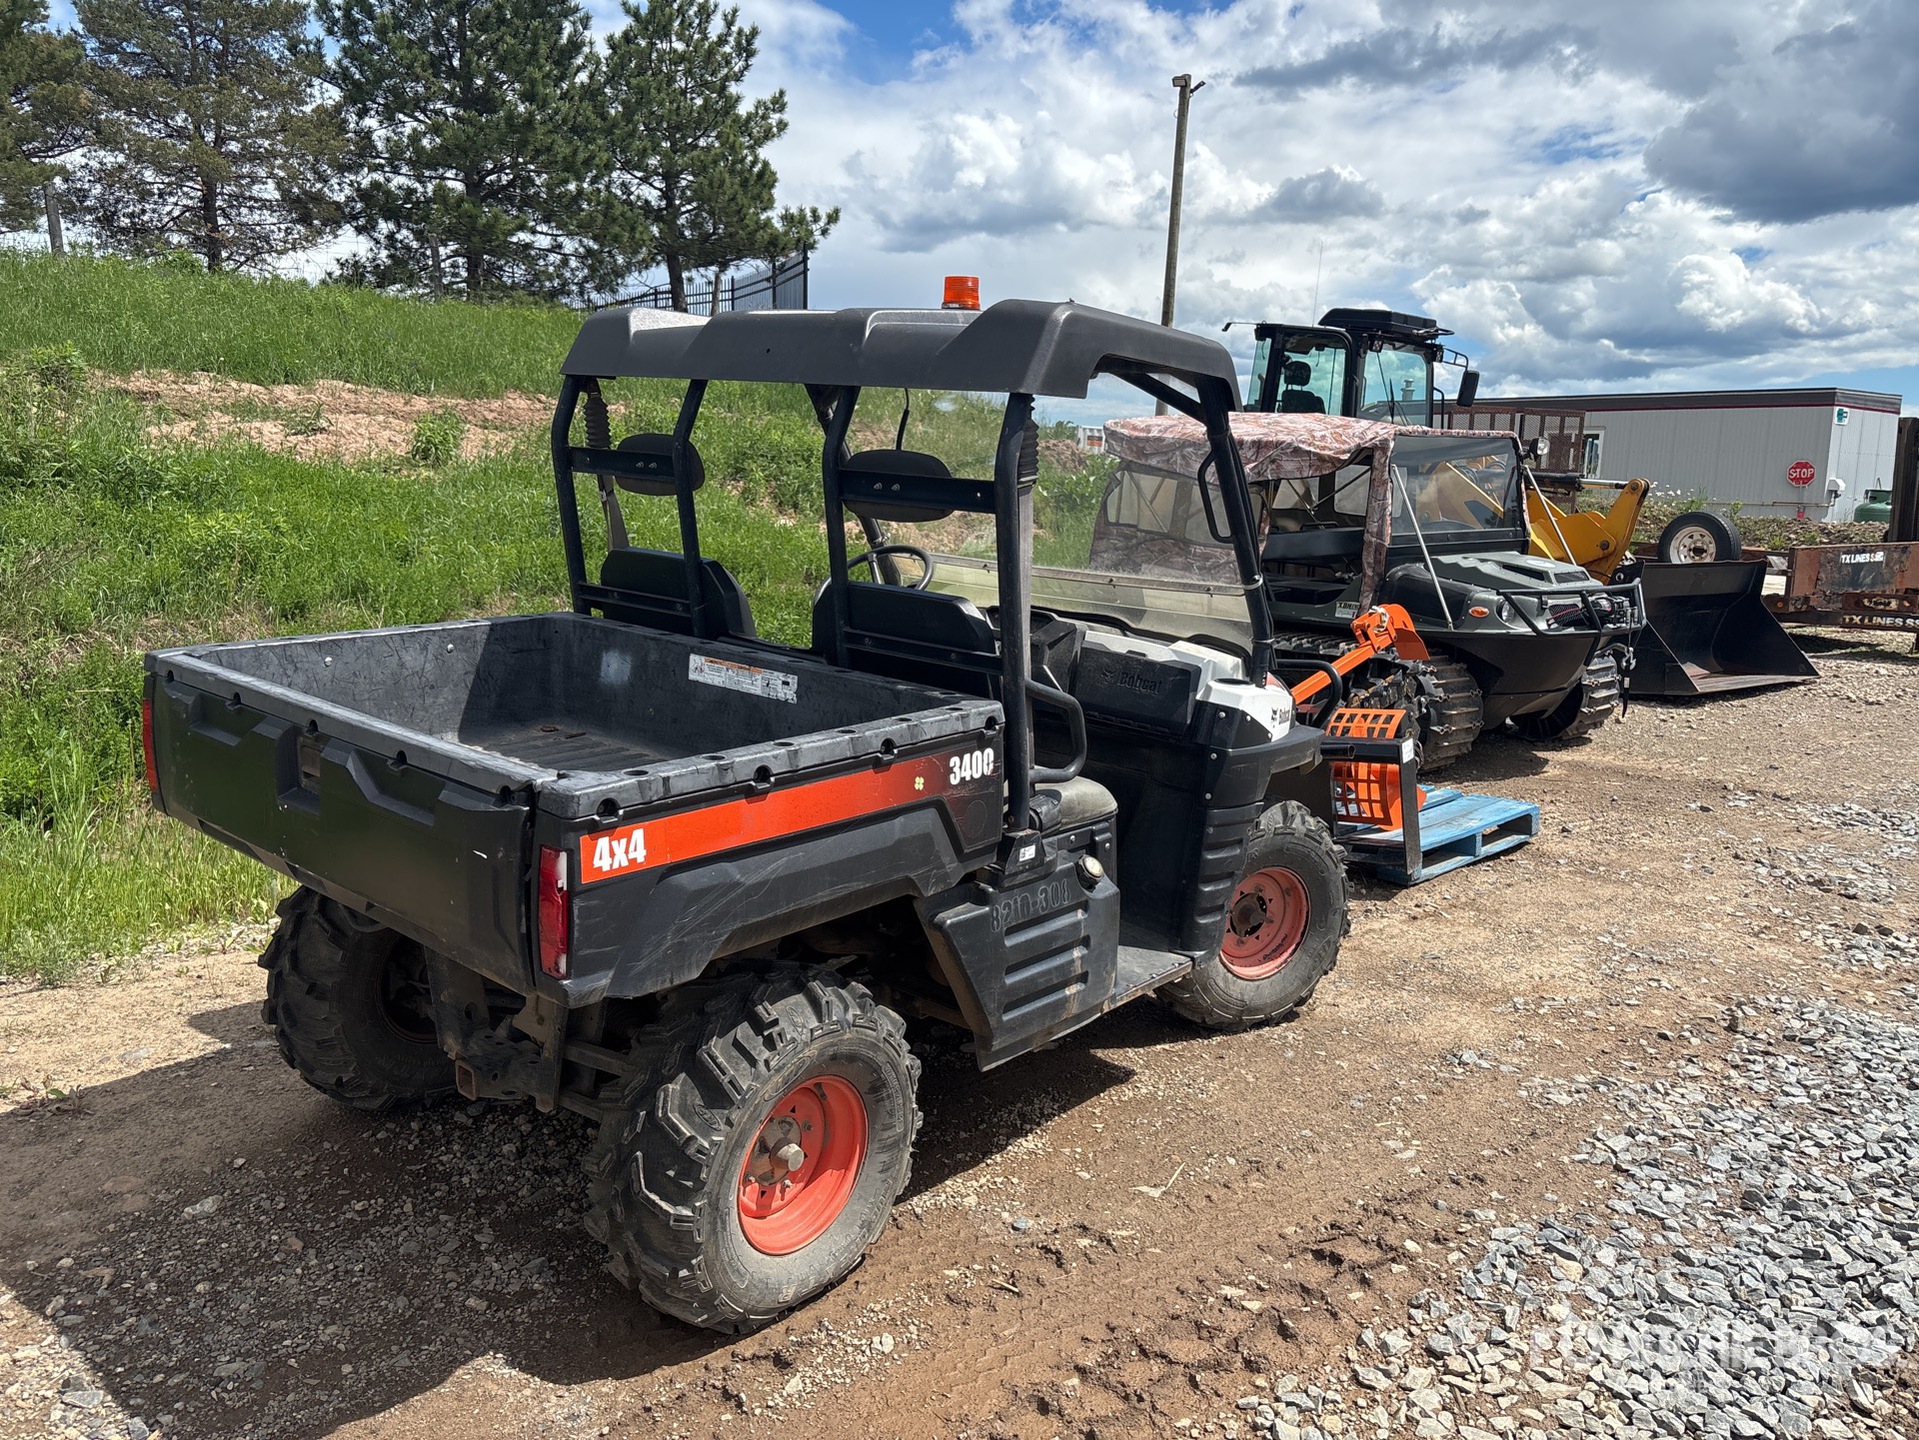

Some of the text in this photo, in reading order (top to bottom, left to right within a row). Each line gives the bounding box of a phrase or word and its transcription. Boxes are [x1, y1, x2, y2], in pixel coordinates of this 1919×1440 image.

[1789, 468, 1814, 479] STOP
[1841, 554, 1851, 564] TX
[1851, 553, 1870, 564] LINES
[1843, 615, 1862, 625] TX
[1864, 616, 1904, 627] LINES
[949, 748, 994, 786] 3400
[592, 828, 646, 871] 4x4
